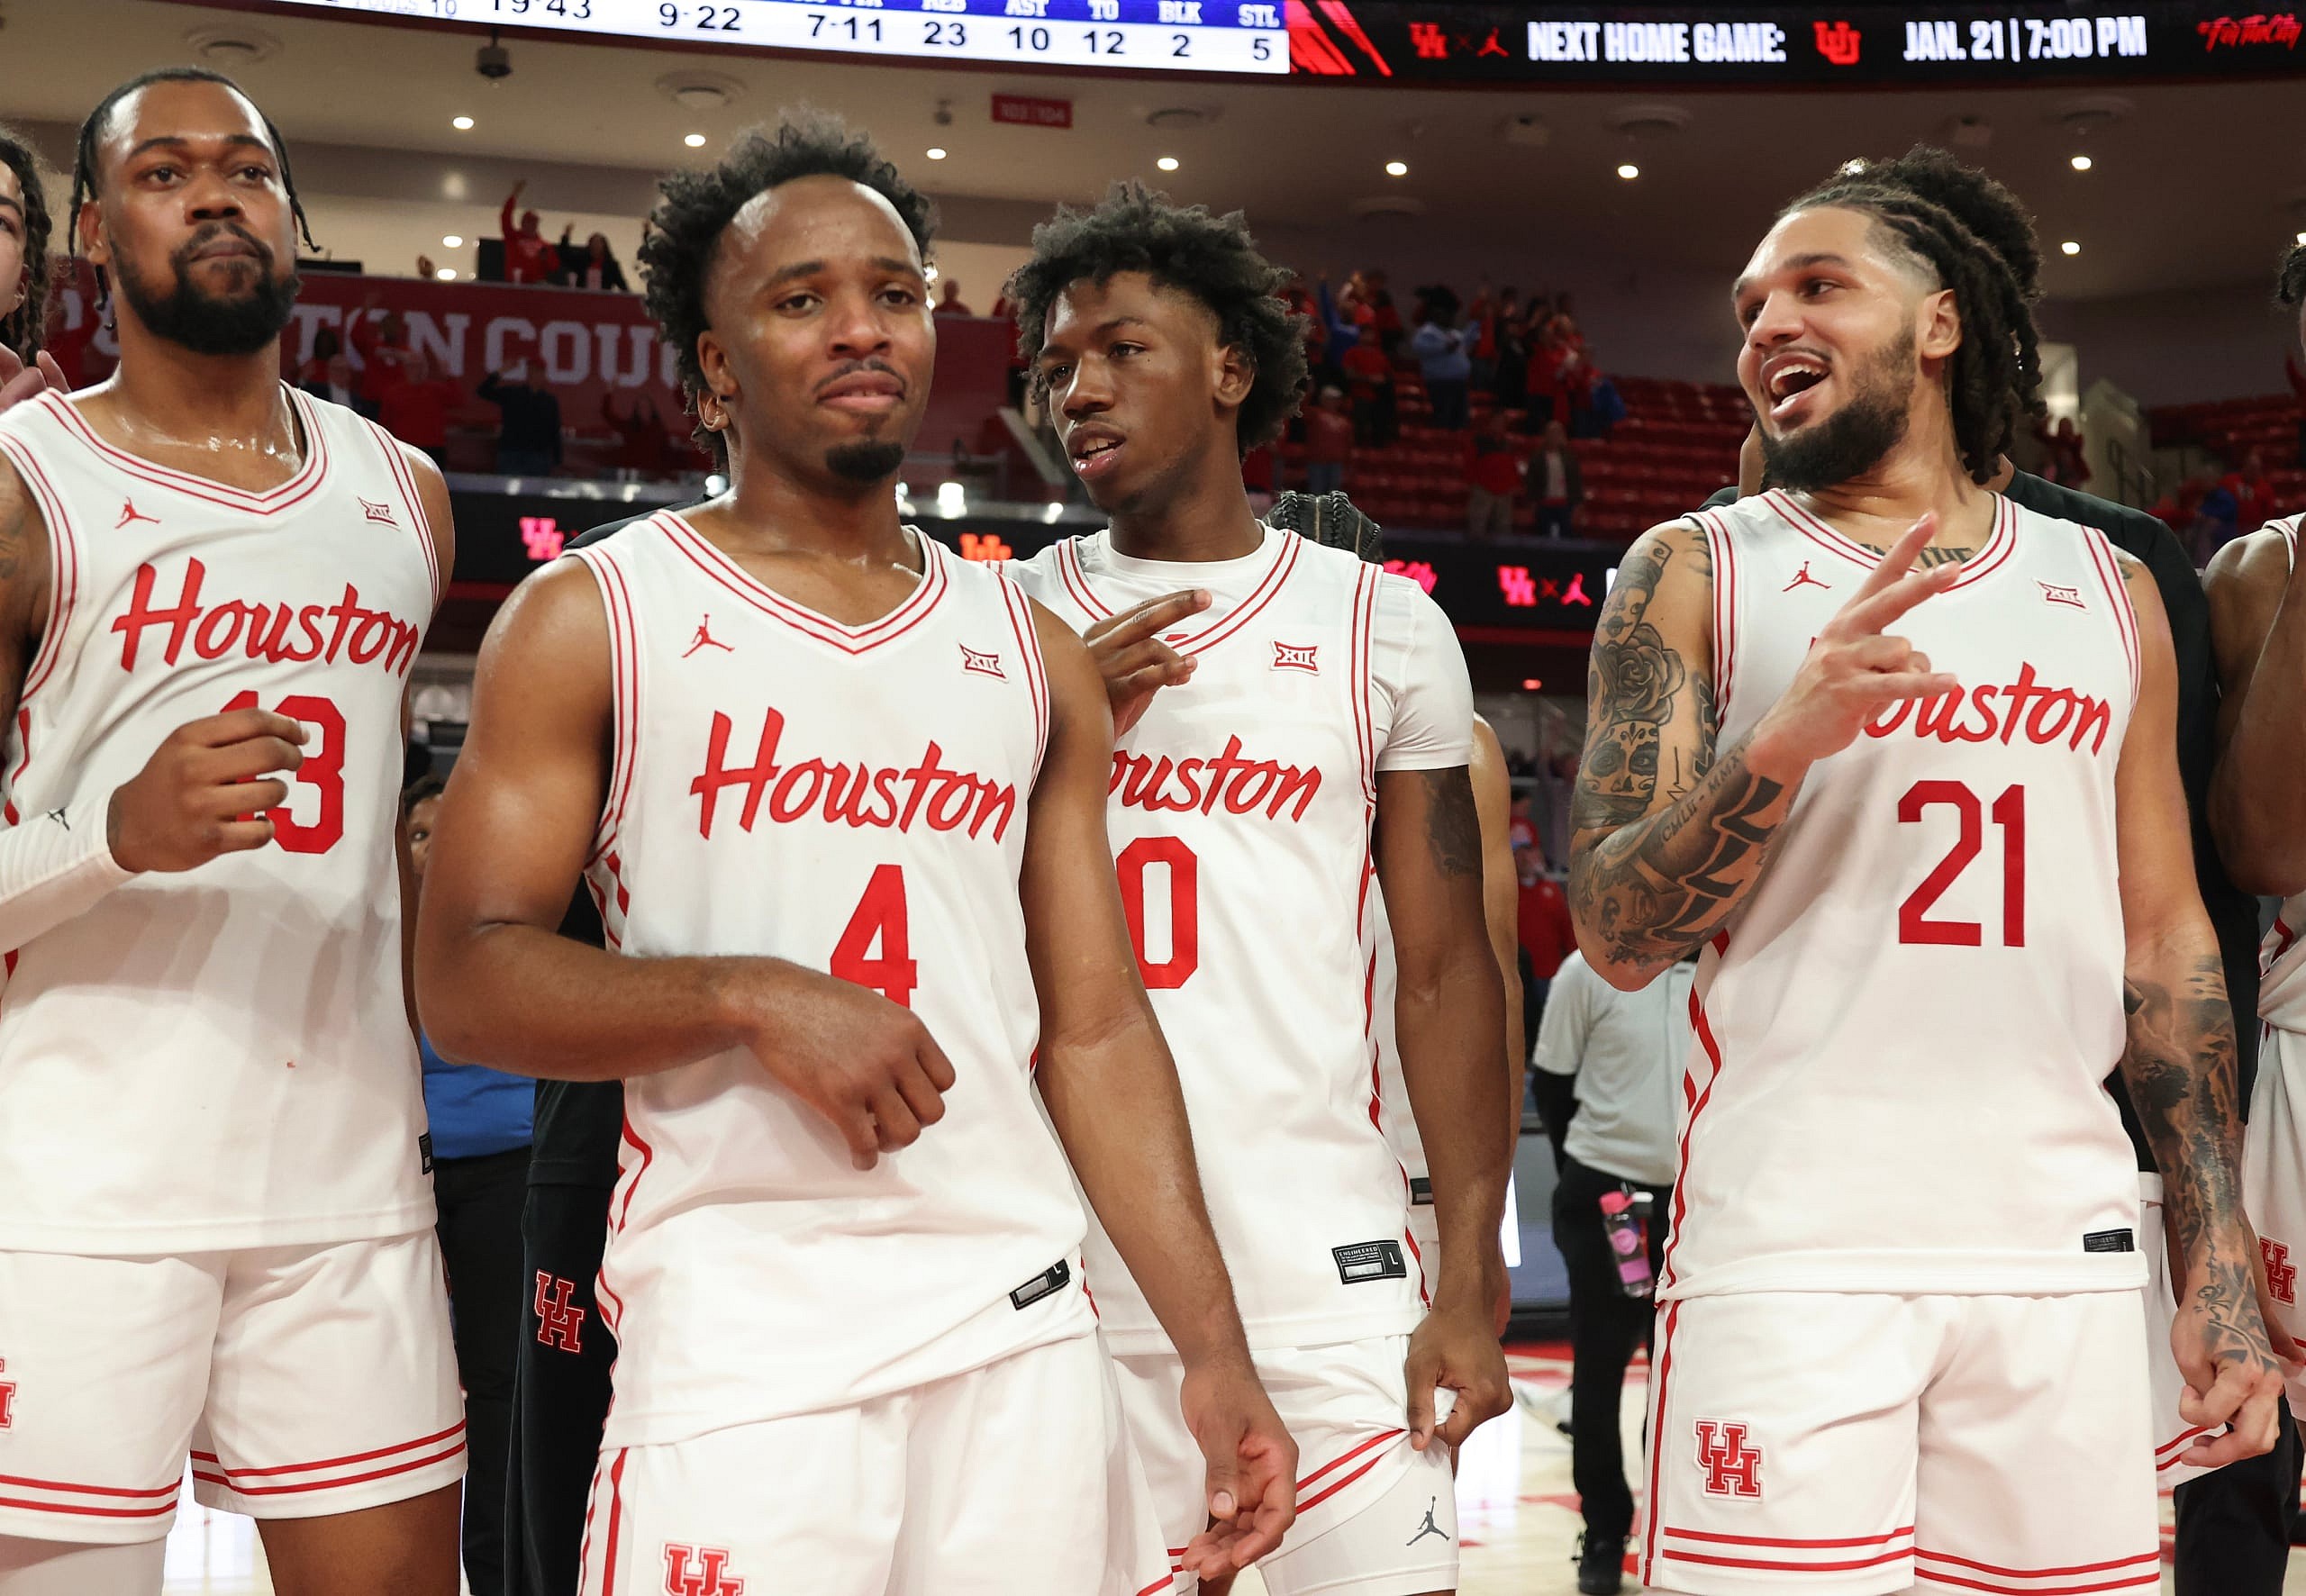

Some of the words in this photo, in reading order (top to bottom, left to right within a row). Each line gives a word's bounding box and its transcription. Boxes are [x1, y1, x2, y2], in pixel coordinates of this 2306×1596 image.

[659, 3, 740, 31] 9-22
[807, 14, 882, 41] 7-11
[924, 22, 966, 46] 23
[1009, 27, 1049, 50] 10
[1084, 31, 1124, 54] 12
[1172, 34, 1190, 57] 2
[1253, 38, 1270, 60] 5
[1004, 0, 1049, 16] AST
[1087, 0, 1120, 20] TO
[1158, 1, 1203, 24] BLK
[1239, 4, 1280, 28] STL
[1528, 21, 1600, 61] NEXT
[1603, 23, 1690, 62] HOME
[1693, 23, 1786, 62] GAME:
[1903, 21, 1966, 61] JAN.
[1970, 21, 2005, 60] 21
[2025, 18, 2093, 59] 7:00
[2097, 16, 2147, 58] PM
[484, 317, 683, 388] COU
[111, 557, 418, 678] Houston
[1274, 640, 1318, 671] XII
[1863, 661, 2111, 757] ouston
[690, 706, 1015, 845] Houston
[1898, 780, 2025, 947] 21
[831, 864, 917, 1009] 4
[1116, 836, 1197, 989] 0
[1388, 1251, 1399, 1265] L
[534, 1269, 585, 1354] UH
[1695, 1420, 1761, 1497] UH
